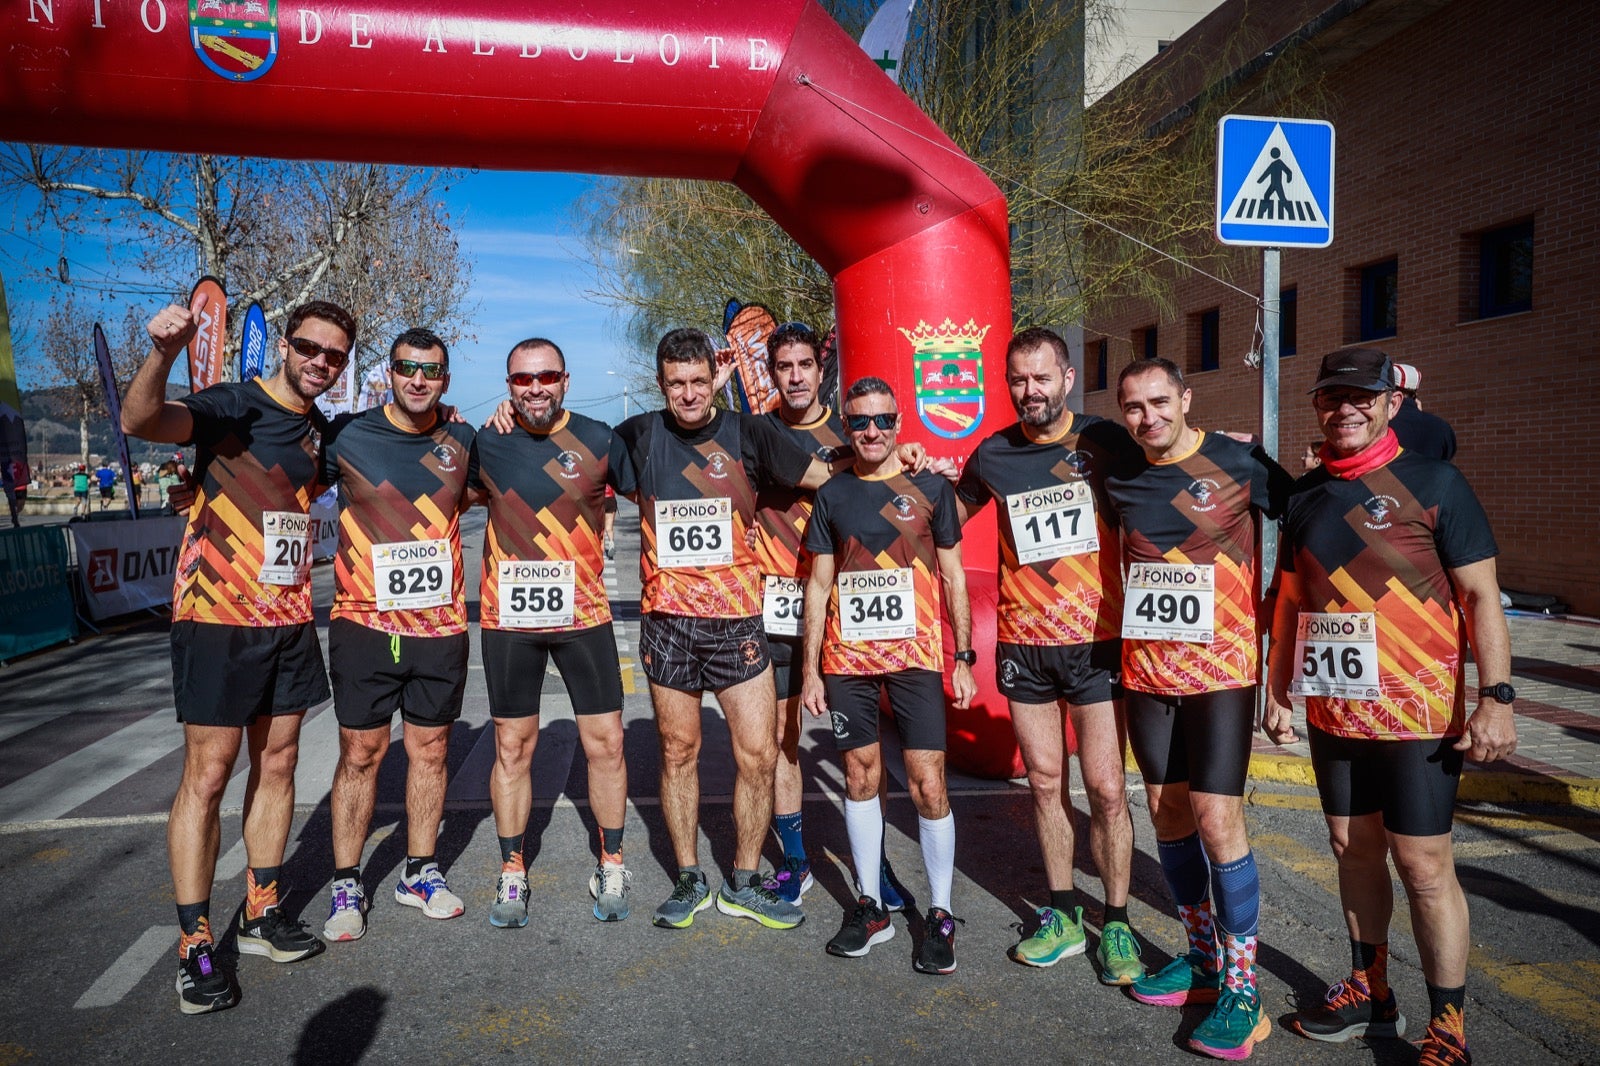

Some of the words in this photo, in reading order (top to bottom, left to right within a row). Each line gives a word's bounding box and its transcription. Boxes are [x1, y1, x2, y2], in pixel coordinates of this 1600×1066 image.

[298, 9, 373, 49] DE
[422, 18, 770, 71] ALBOLOTE
[193, 311, 212, 390] HSN
[672, 505, 717, 517] FONDO
[1025, 489, 1074, 508] FONDO
[669, 524, 722, 552] 663
[1025, 508, 1081, 543] 117
[1364, 521, 1392, 530] PELIGROS
[391, 546, 437, 560] FONDO
[388, 565, 443, 595] 829
[515, 567, 561, 578] FONDO
[852, 575, 897, 589] FONDO
[1144, 570, 1196, 584] FONDO
[510, 587, 564, 612] 558
[849, 595, 903, 623] 348
[1135, 593, 1200, 624] 490
[1306, 621, 1355, 635] FONDO
[1302, 646, 1363, 679] 516
